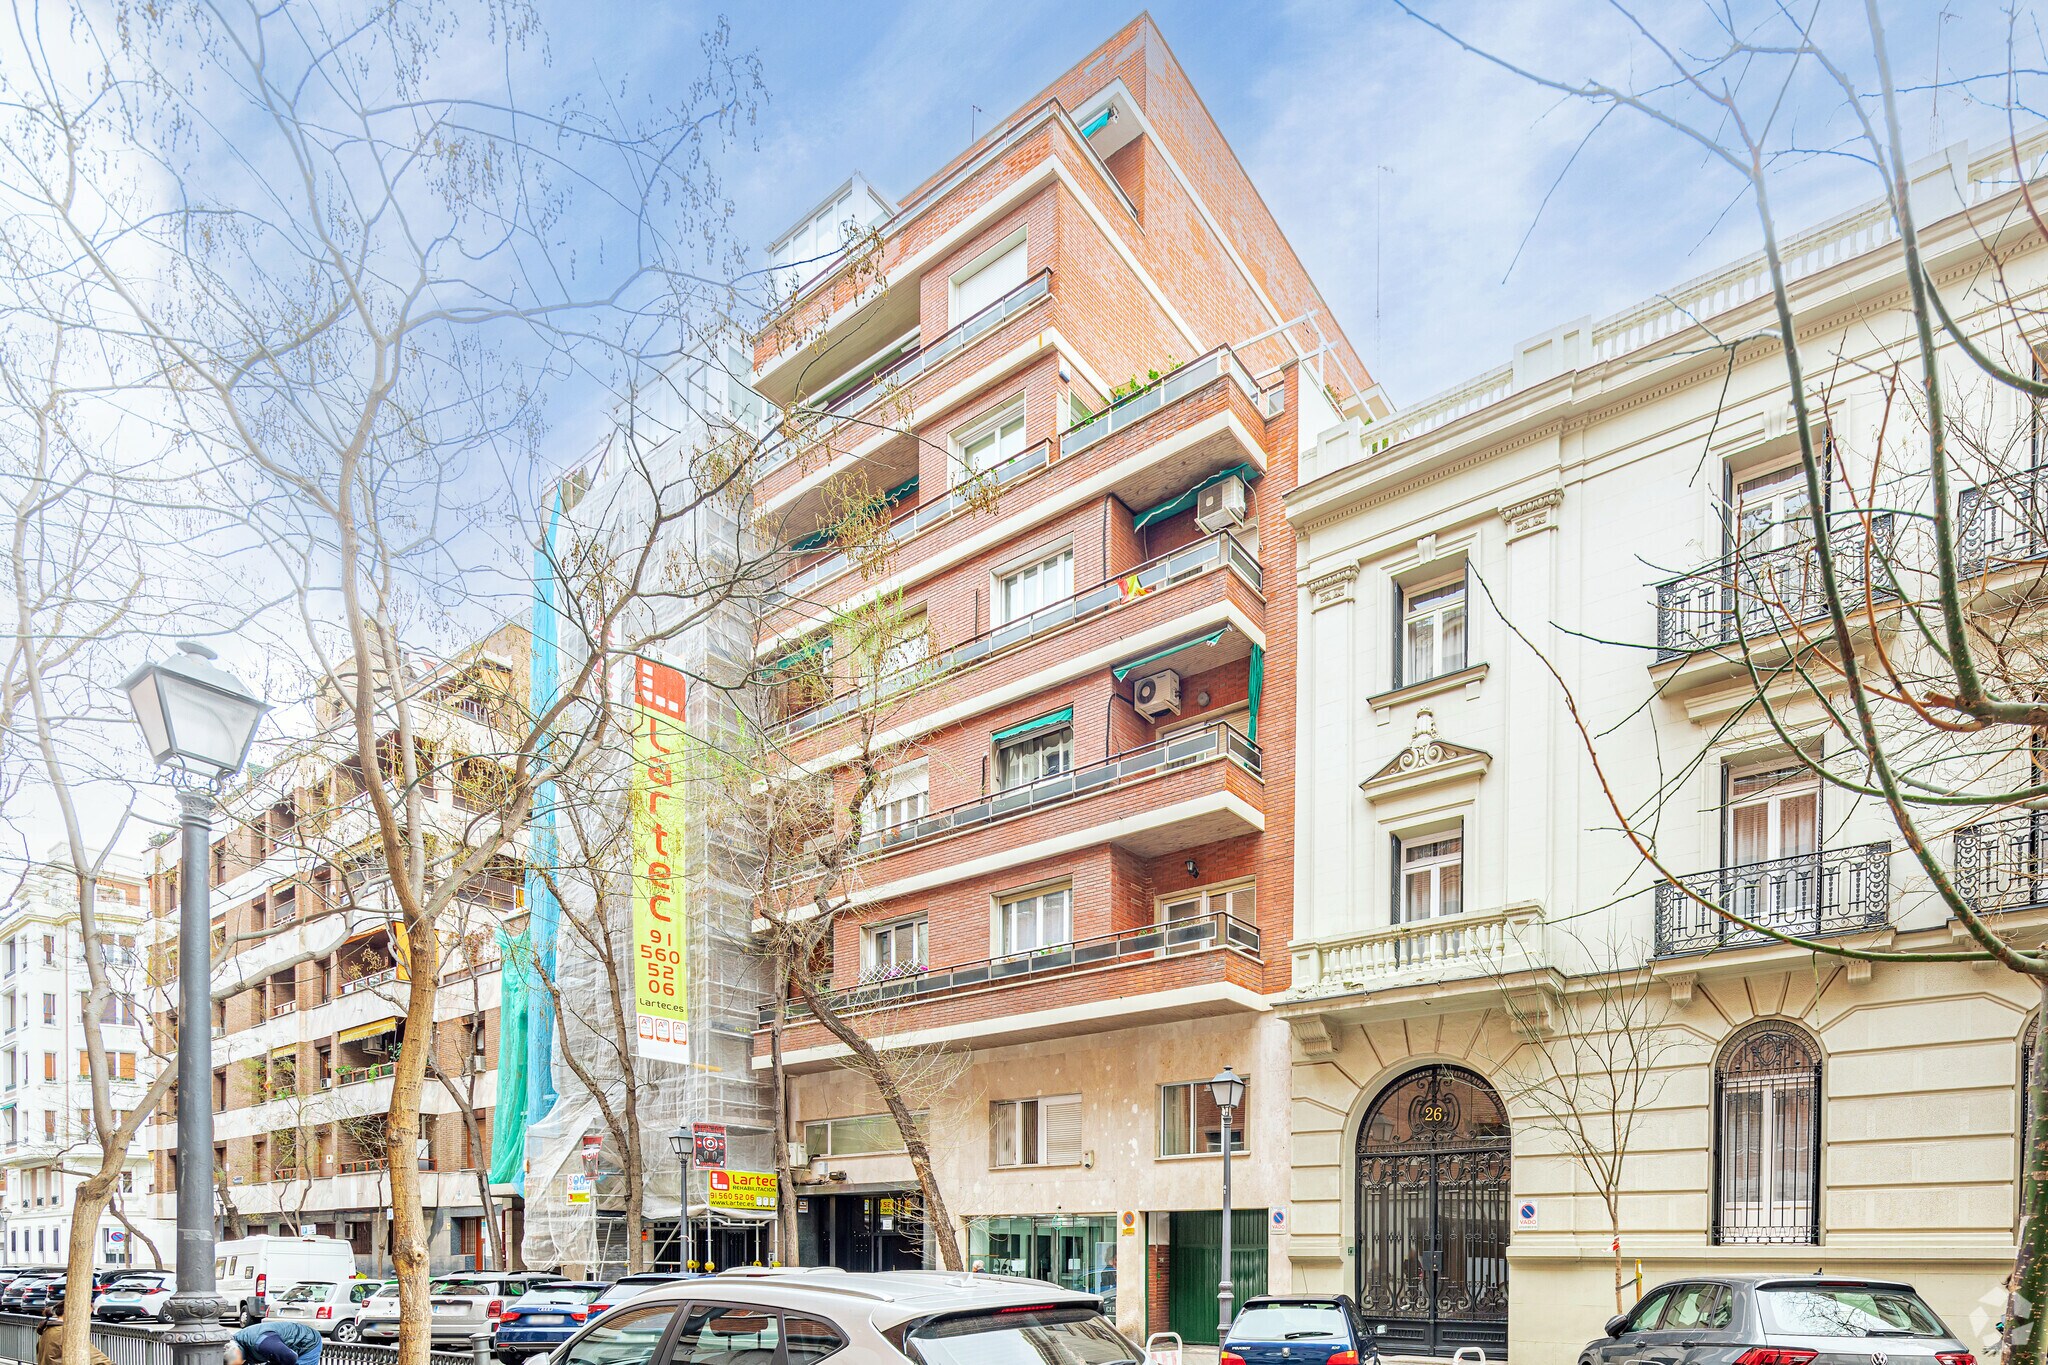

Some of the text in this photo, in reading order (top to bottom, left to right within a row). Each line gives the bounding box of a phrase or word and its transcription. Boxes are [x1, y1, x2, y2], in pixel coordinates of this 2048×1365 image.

[650, 929, 671, 946] 91
[641, 944, 680, 965] 560
[648, 962, 674, 980] 52
[648, 979, 675, 997] 06
[639, 997, 685, 1013] Lartec.es
[1425, 1106, 1442, 1121] 26
[732, 1174, 776, 1187] Lartec
